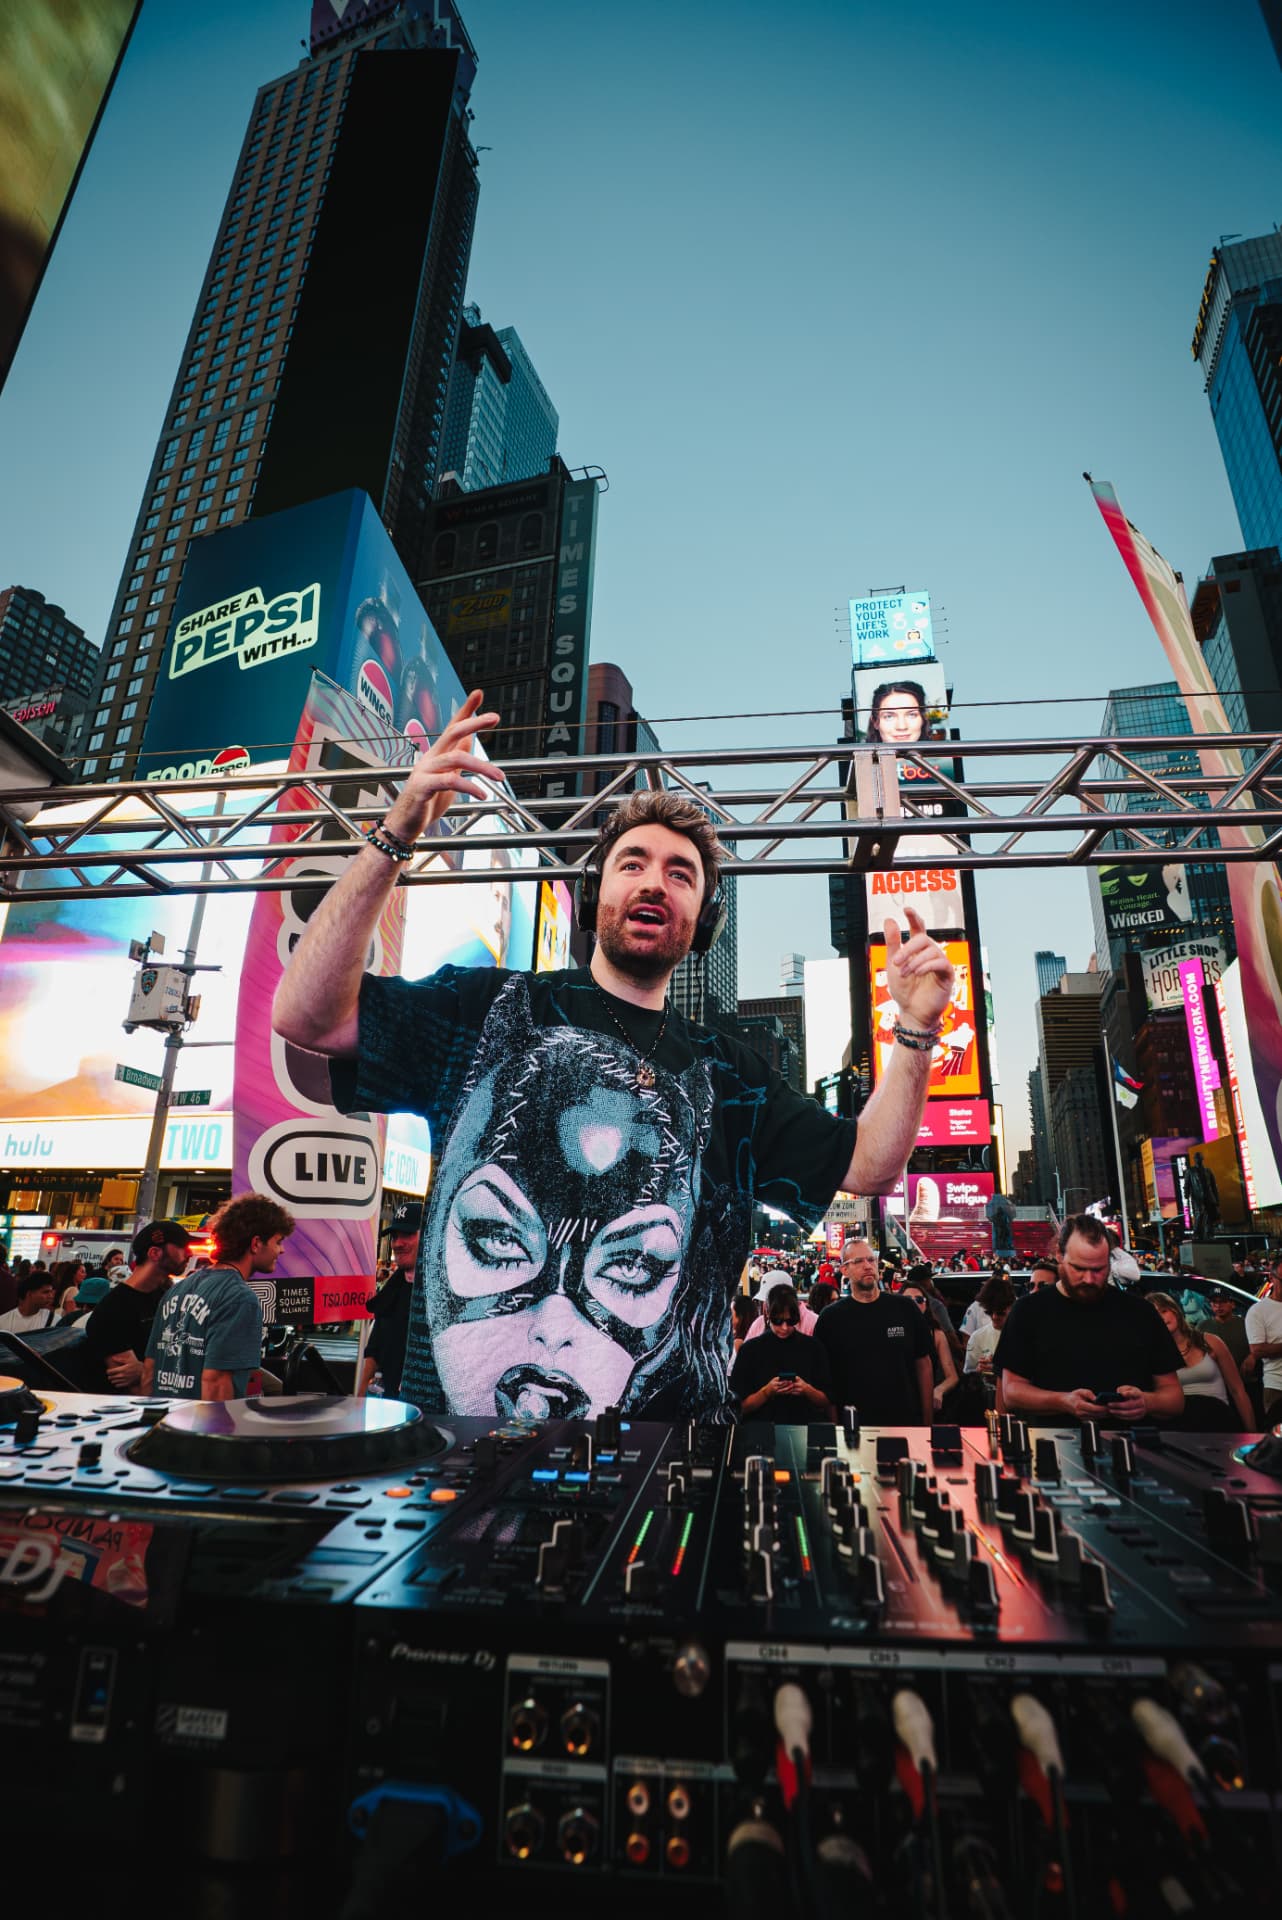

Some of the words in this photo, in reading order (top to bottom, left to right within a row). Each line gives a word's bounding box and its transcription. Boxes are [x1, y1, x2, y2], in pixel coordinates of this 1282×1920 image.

[559, 496, 584, 614] TIMES
[179, 598, 242, 636] SHARE
[245, 593, 258, 608] A
[855, 599, 903, 611] PROTECT
[856, 611, 885, 620] YOUR
[174, 589, 314, 673] PEPSI
[856, 620, 887, 630] LIFE'S
[857, 629, 890, 640] WORK
[243, 633, 312, 663] WITH...
[361, 677, 391, 726] WINGS
[547, 634, 575, 797] SQUAE
[872, 869, 957, 894] ACCESS
[1150, 945, 1187, 969] LITTLE
[1189, 944, 1219, 958] SHOP
[1185, 972, 1217, 1130] BEAUTYNEWYORK.COM
[125, 1066, 161, 1091] Broadway
[179, 1092, 187, 1104] W
[190, 1092, 200, 1103] 46
[4, 1134, 53, 1156] hulu
[166, 1124, 223, 1160] TWO
[295, 1152, 367, 1184] LIVE
[946, 1182, 978, 1196] Swipe
[946, 1194, 988, 1205] Fatigue
[279, 1297, 311, 1307] SQUARE
[282, 1288, 309, 1297] TIMES
[162, 1295, 179, 1320] US
[180, 1294, 210, 1325] OPEN
[281, 1306, 309, 1314] ALLIANCE
[390, 1642, 470, 1663] Pioneer
